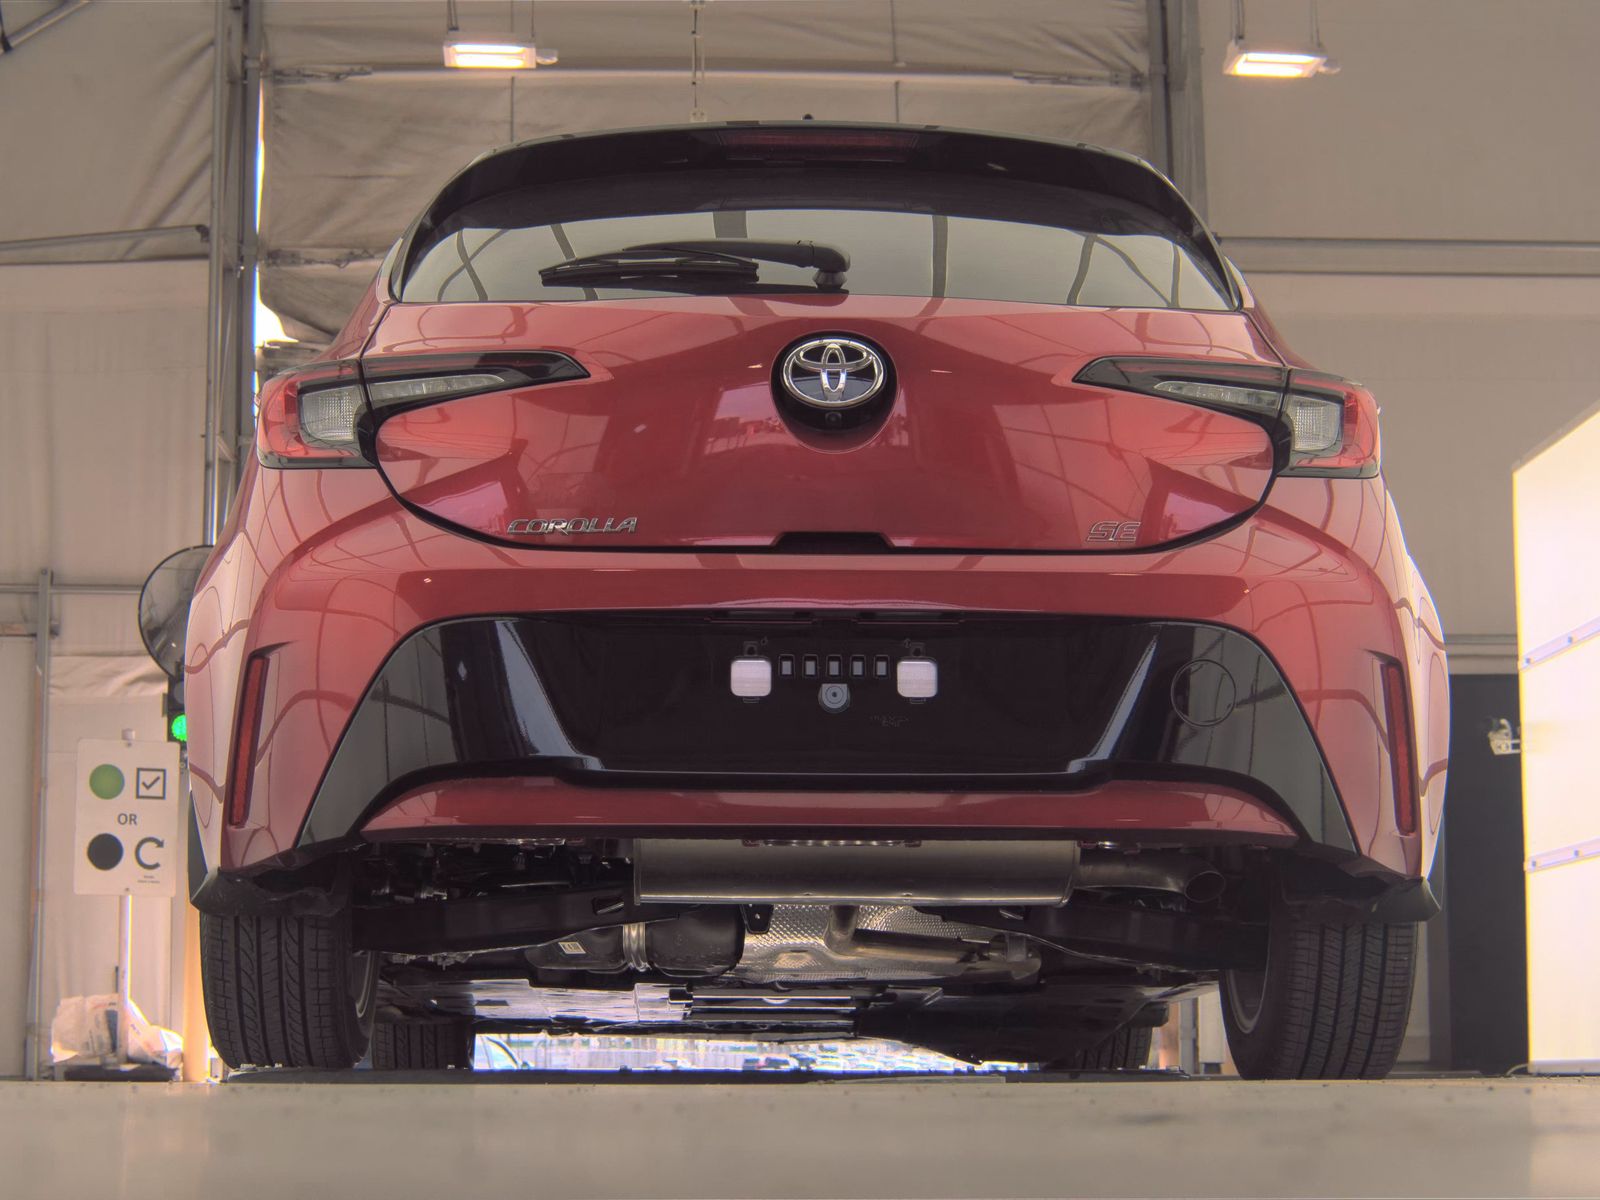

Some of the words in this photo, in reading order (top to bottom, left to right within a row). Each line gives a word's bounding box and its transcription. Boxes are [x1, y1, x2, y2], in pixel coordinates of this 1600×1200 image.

[507, 517, 638, 535] COROLLA
[1086, 520, 1141, 542] SE
[117, 812, 138, 826] OR
